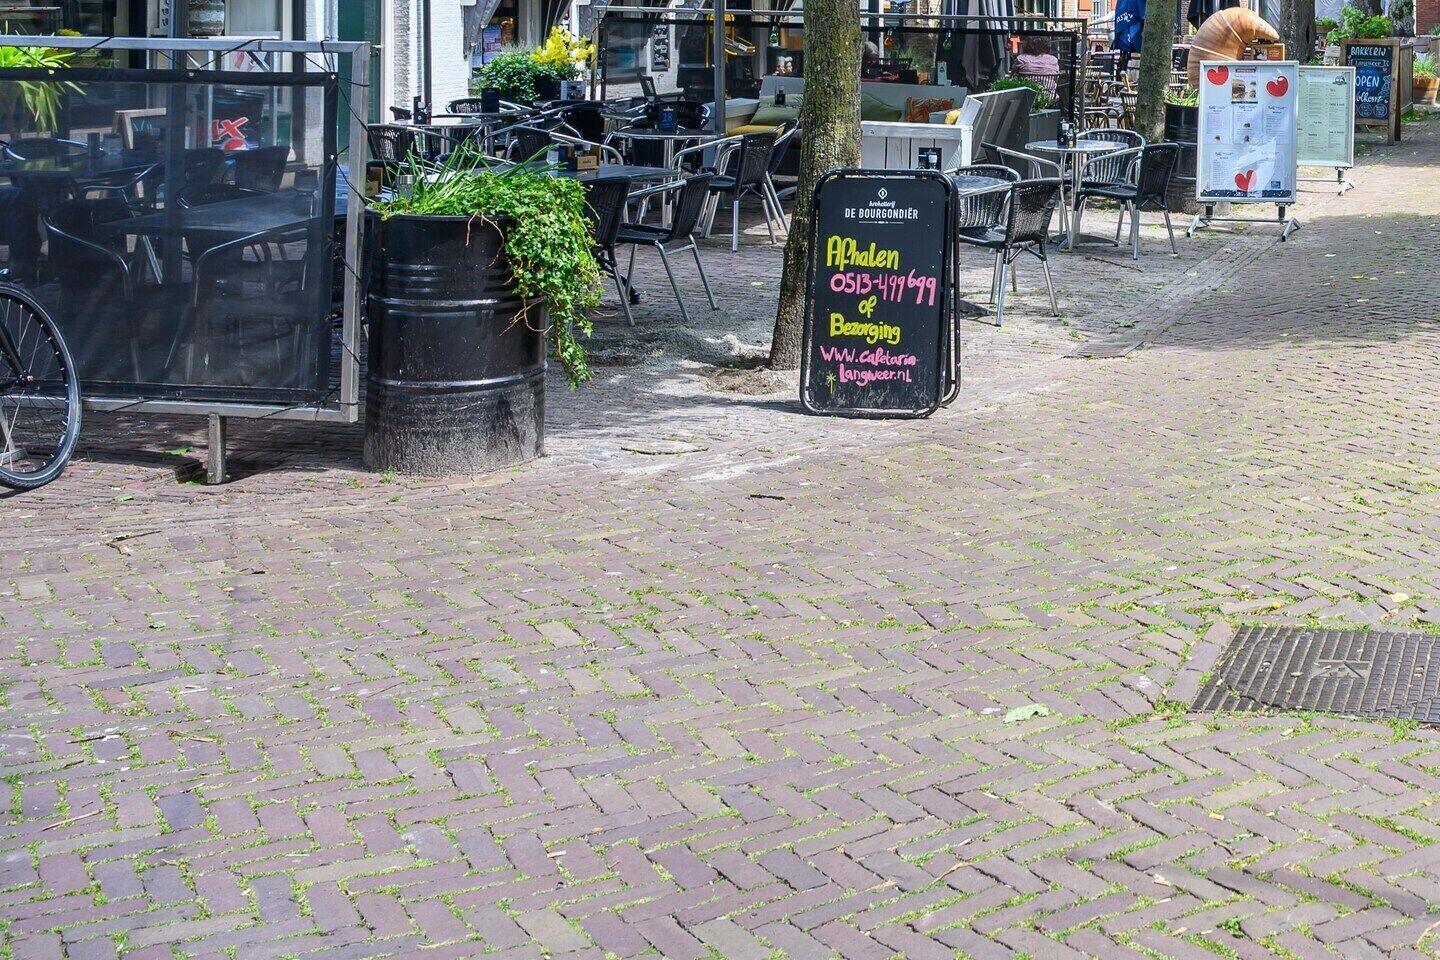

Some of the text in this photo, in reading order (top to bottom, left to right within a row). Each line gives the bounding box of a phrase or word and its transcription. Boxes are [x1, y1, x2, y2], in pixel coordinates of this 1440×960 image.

[1350, 46, 1387, 57] BAKKERIJ
[1355, 75, 1380, 87] OPEN
[844, 206, 919, 220] DE BOURGONDIËR
[826, 234, 900, 272] Afhalen
[829, 269, 937, 307] 0513-499699
[858, 294, 877, 319] of
[829, 312, 901, 345] Bezorging
